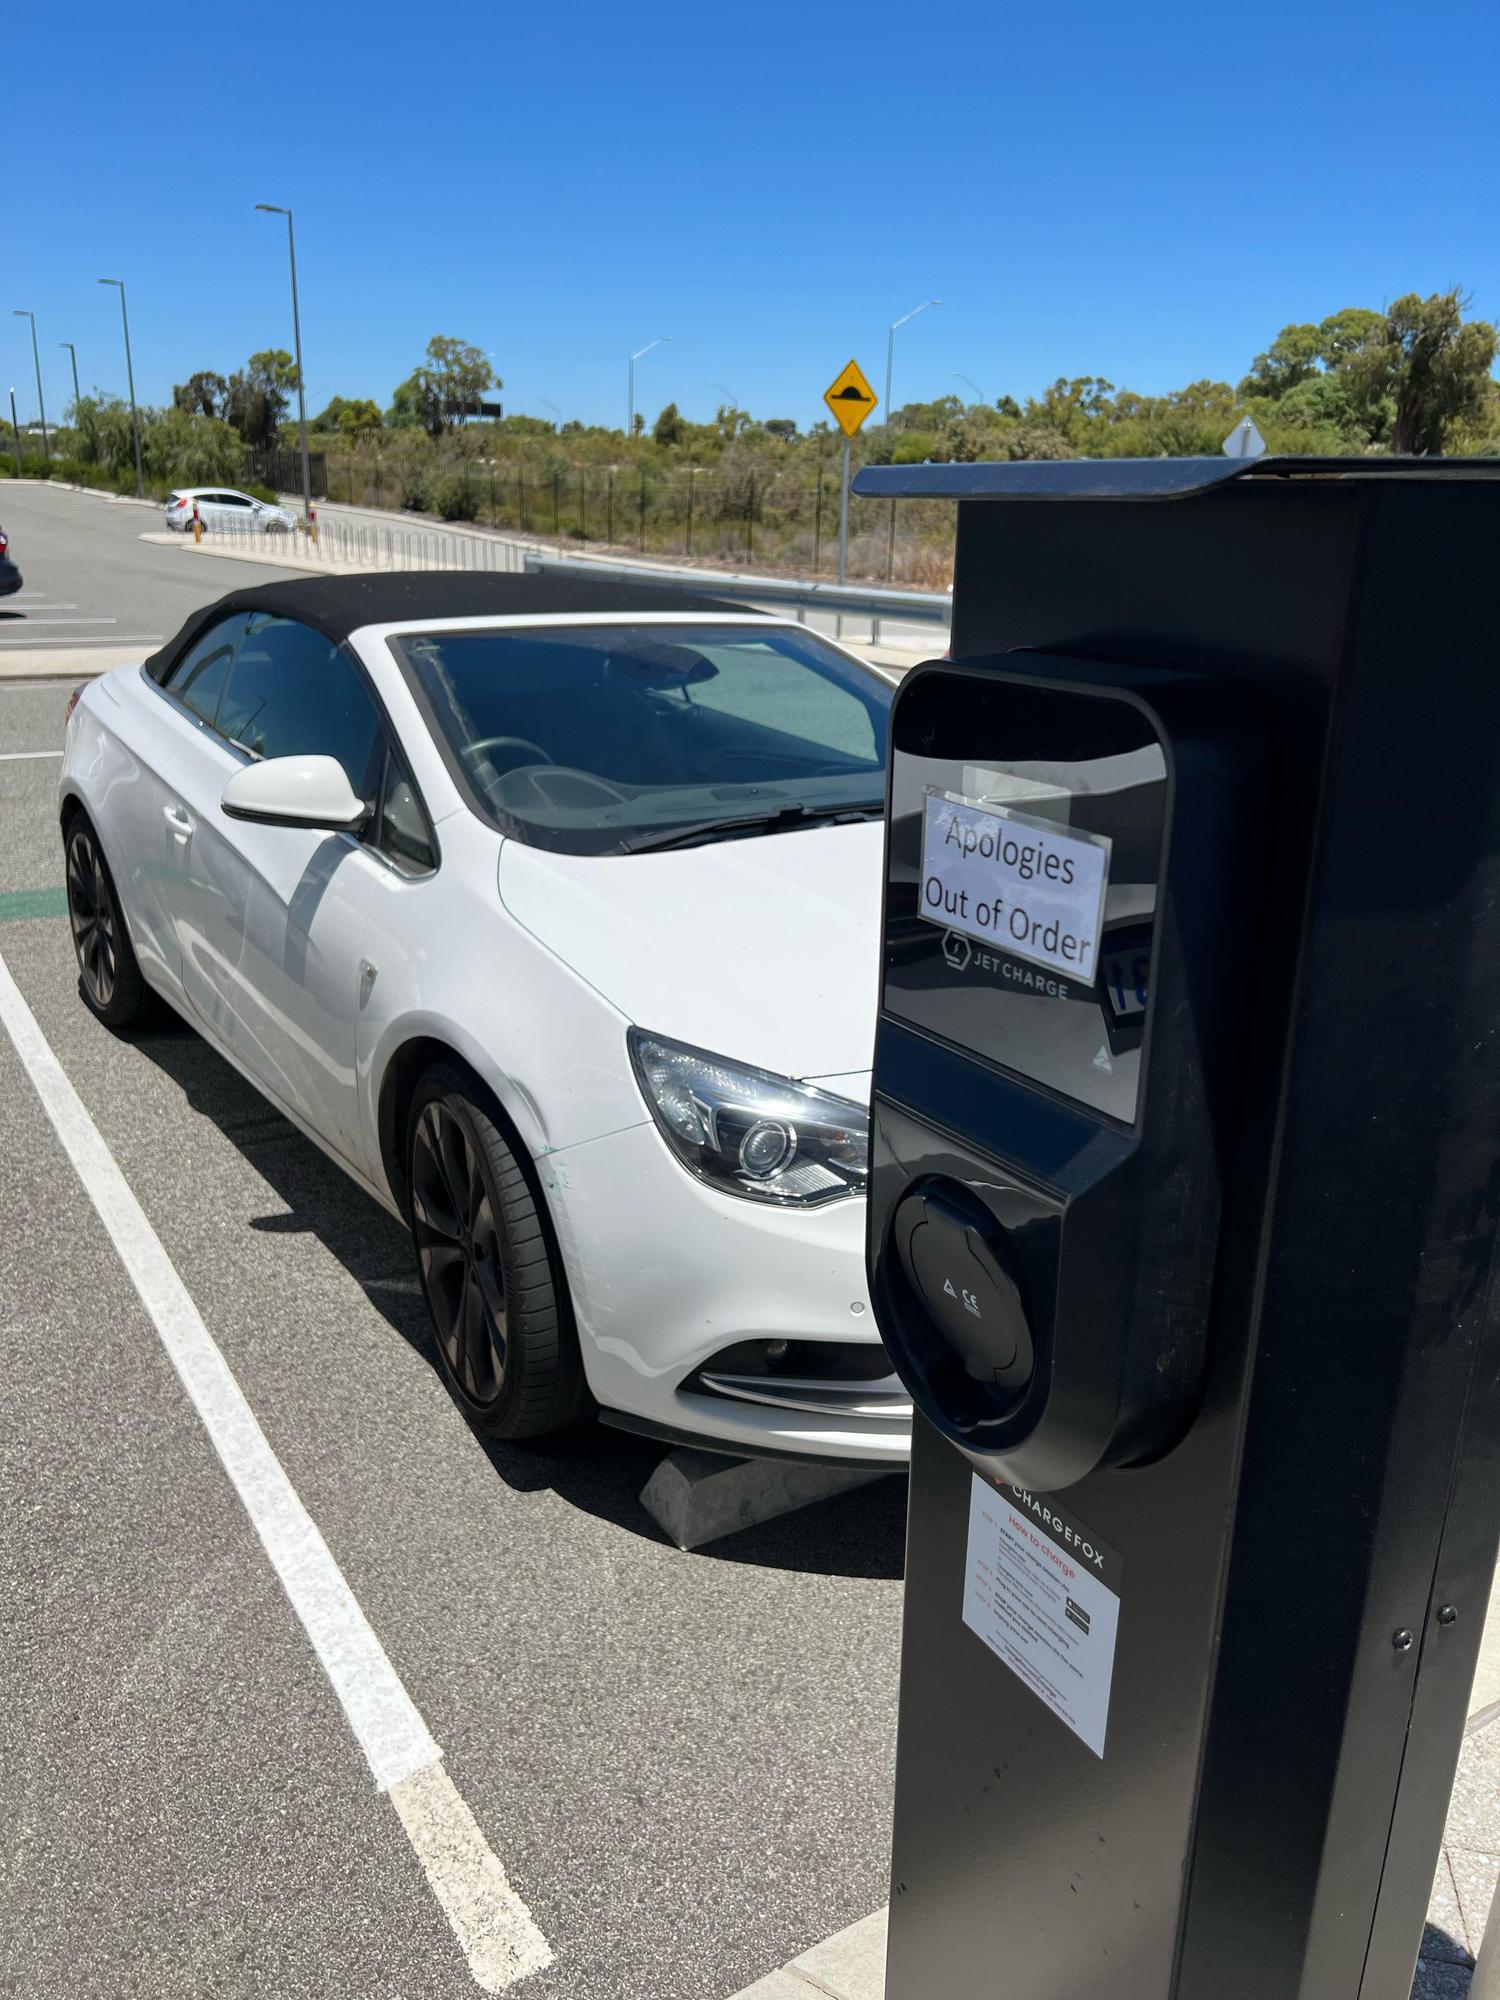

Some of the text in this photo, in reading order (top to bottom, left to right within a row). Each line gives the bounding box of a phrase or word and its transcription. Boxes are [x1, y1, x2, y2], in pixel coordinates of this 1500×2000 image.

[945, 816, 1075, 885] Apologies
[925, 876, 1091, 964] Out of Order
[1007, 1513, 1029, 1537] How
[1030, 1532, 1040, 1548] to
[1041, 1545, 1076, 1579] charge
[1012, 1485, 1104, 1569] CHARGEFOX
